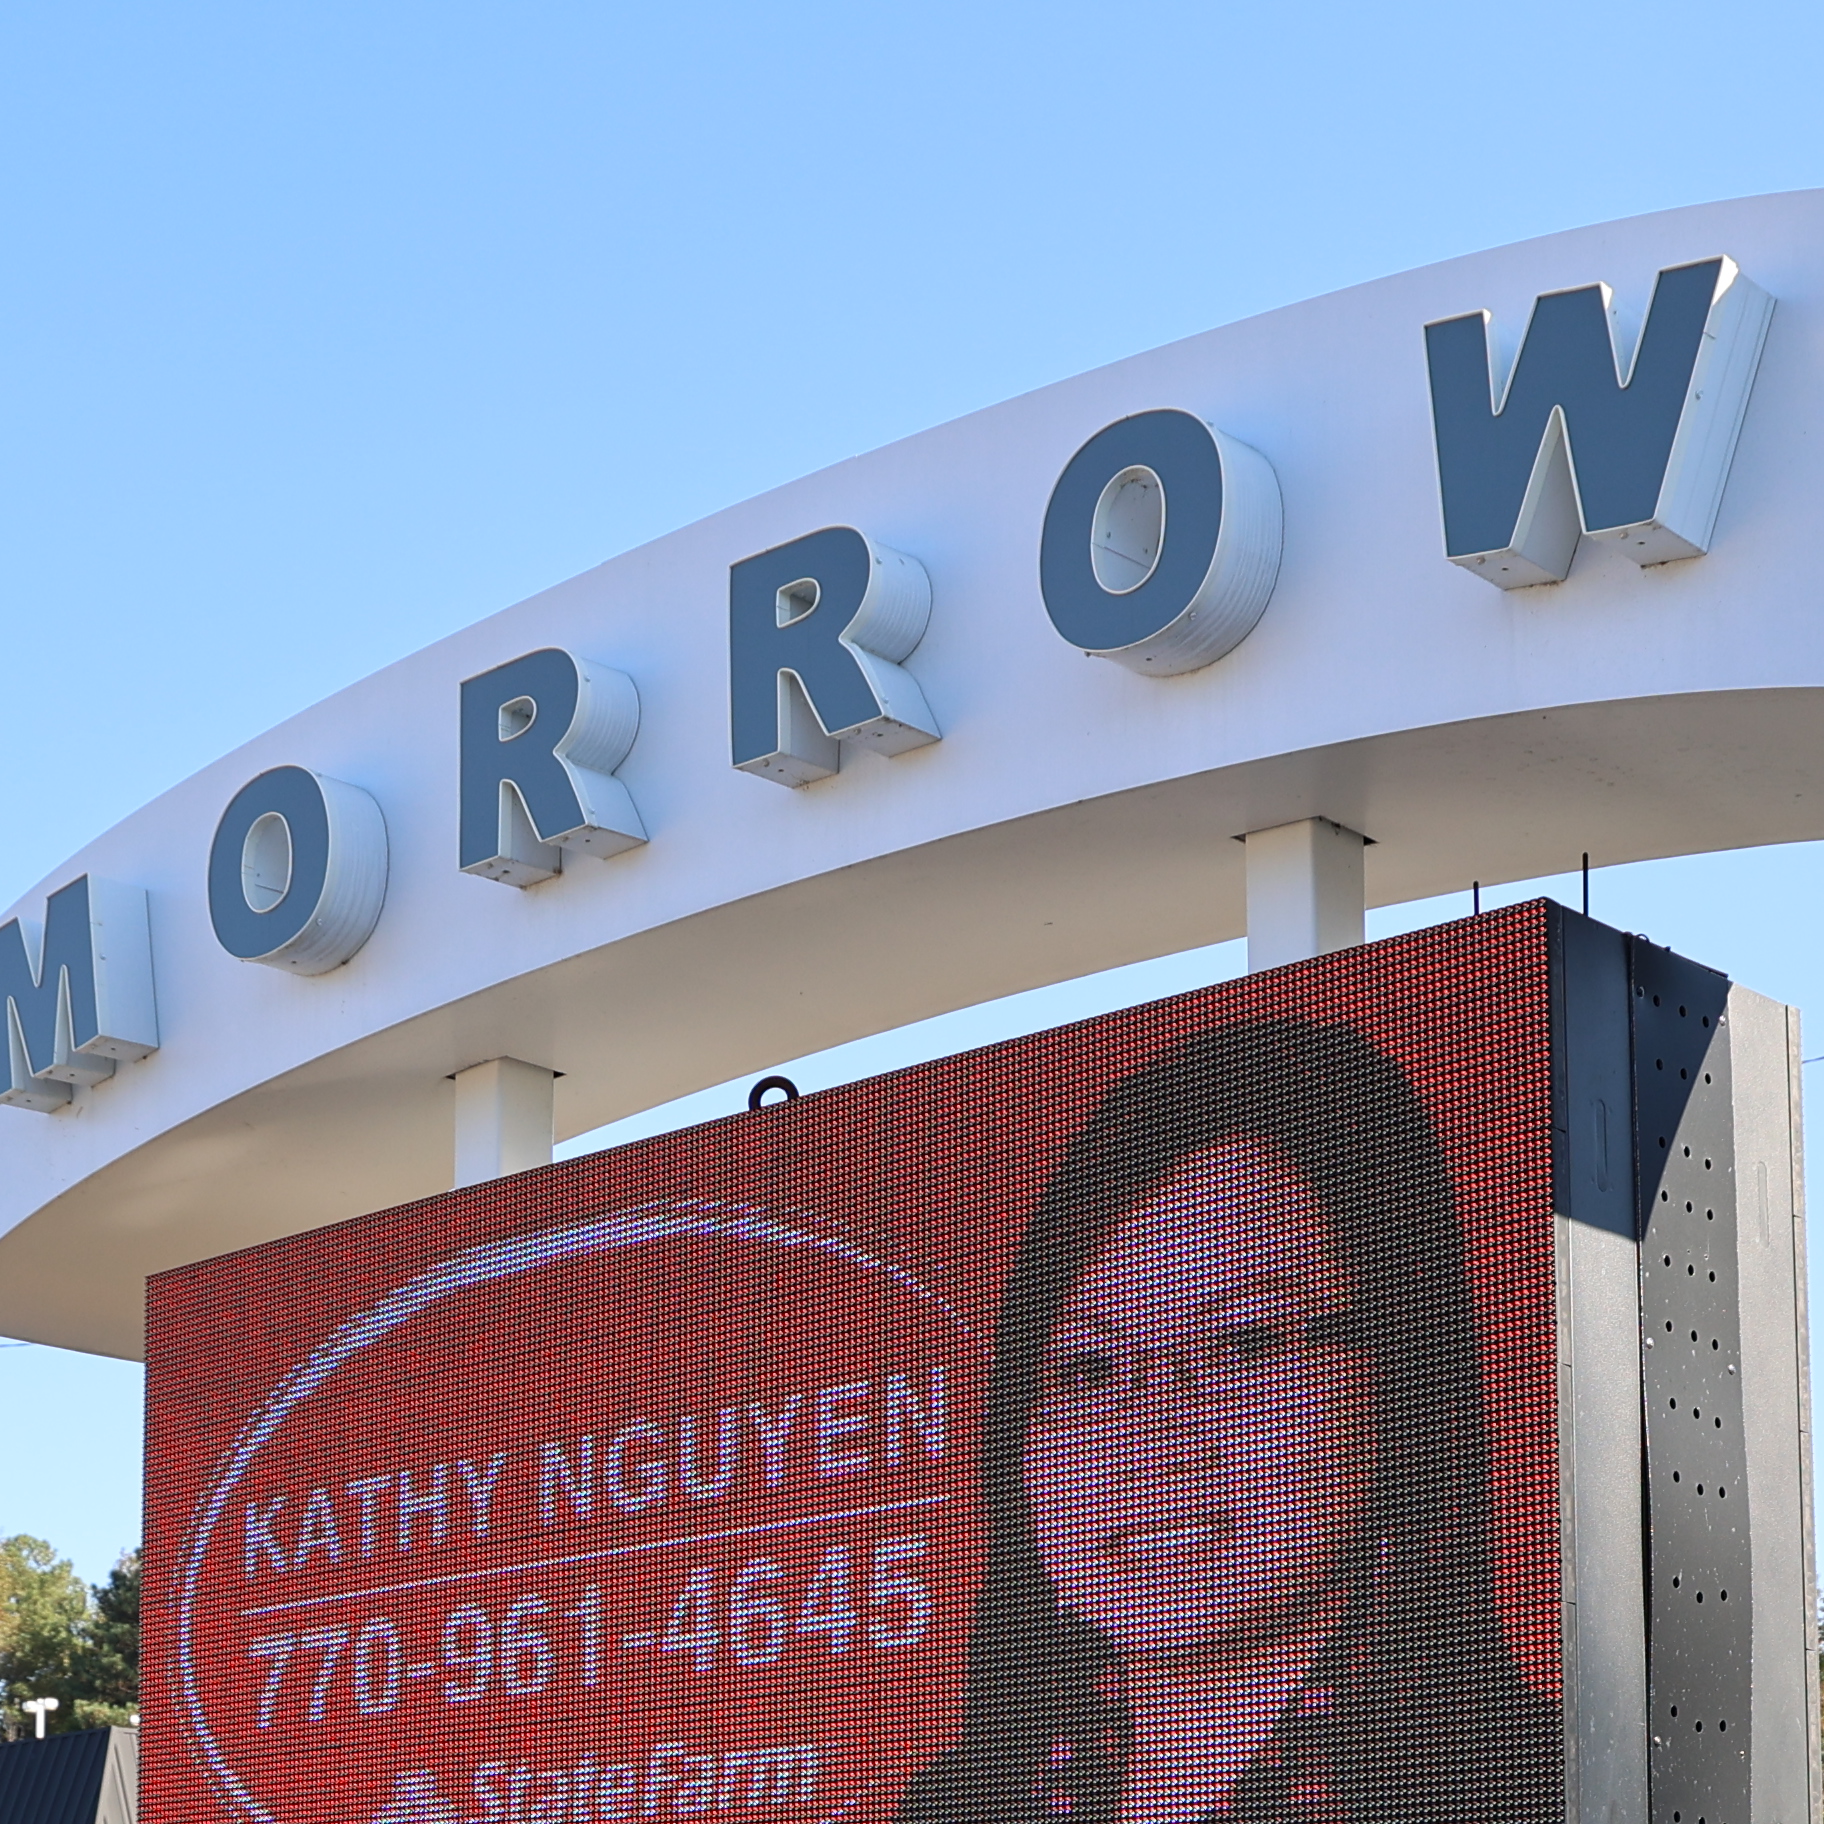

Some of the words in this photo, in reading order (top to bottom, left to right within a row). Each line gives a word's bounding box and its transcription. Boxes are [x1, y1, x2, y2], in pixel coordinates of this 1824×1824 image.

[244, 1450, 509, 1581] KATHY
[538, 1366, 949, 1528] NGUYEN
[249, 1536, 934, 1732] 770-961-4645
